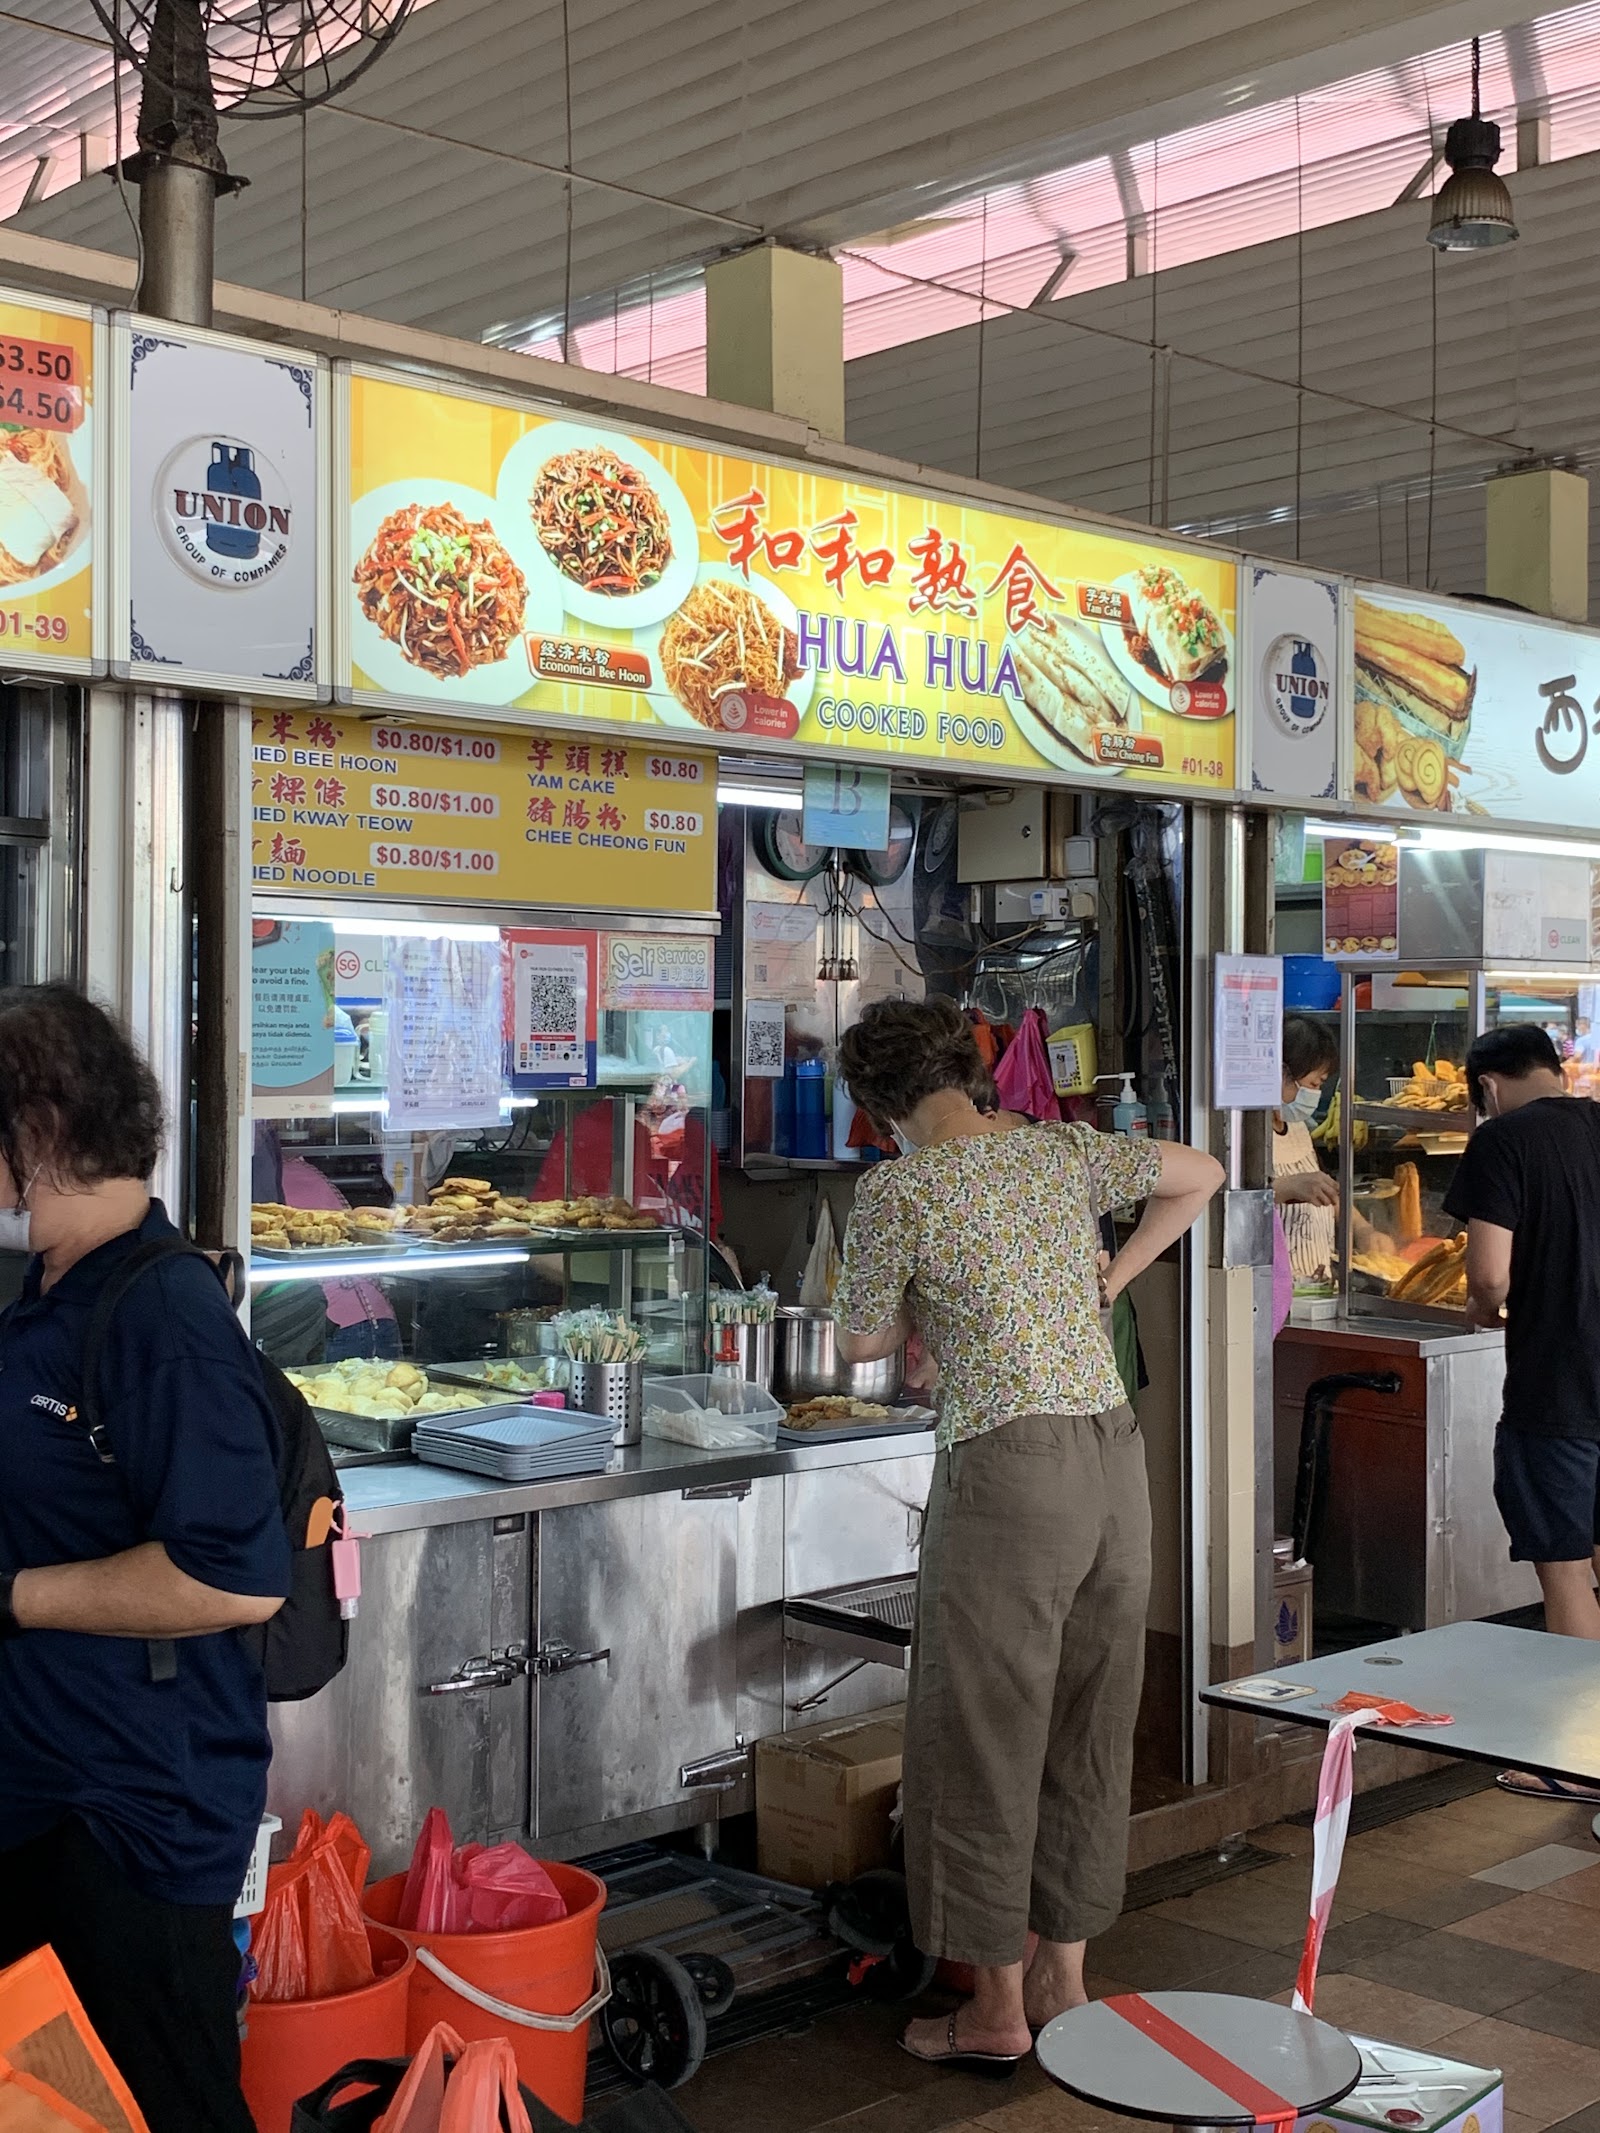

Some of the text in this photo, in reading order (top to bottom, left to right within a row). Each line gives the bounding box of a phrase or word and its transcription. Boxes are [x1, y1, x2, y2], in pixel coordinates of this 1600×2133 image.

[173, 489, 291, 535] UNION
[175, 525, 287, 582] GROUP OF COMPANIES
[711, 489, 1066, 633] 和和熟食
[540, 640, 611, 665] 经济米粉
[797, 611, 1025, 701] HUA HUA
[539, 658, 647, 684] Economical Bee Hoon
[1276, 673, 1329, 700] UNION
[753, 716, 787, 729] calories
[754, 704, 789, 718] Lower in
[817, 697, 1006, 749] COOKED FOOD
[252, 711, 344, 749] 米粉
[377, 729, 496, 759] $0.80/$1.00
[252, 747, 398, 773] IED BEE HOON
[651, 758, 698, 779] $0.80
[1181, 757, 1224, 777] #01-38
[252, 771, 347, 809] 粿條
[527, 773, 615, 794] YAM CAKE
[829, 764, 862, 816] B
[376, 787, 494, 814] $0.80/$1.00
[253, 807, 414, 832] IED KWAY TEOW
[650, 812, 697, 832] $0.80
[252, 832, 306, 867] 麵
[525, 829, 686, 854] CHEE CHEONG FUN
[376, 846, 494, 871] $0.80/$1.00
[253, 866, 376, 887] IED NOODLE
[252, 966, 310, 976] lear your table
[339, 959, 358, 971] SG
[612, 943, 706, 981] Self Service
[260, 977, 283, 985] avoid
[31, 1394, 68, 1416] CERTIS
